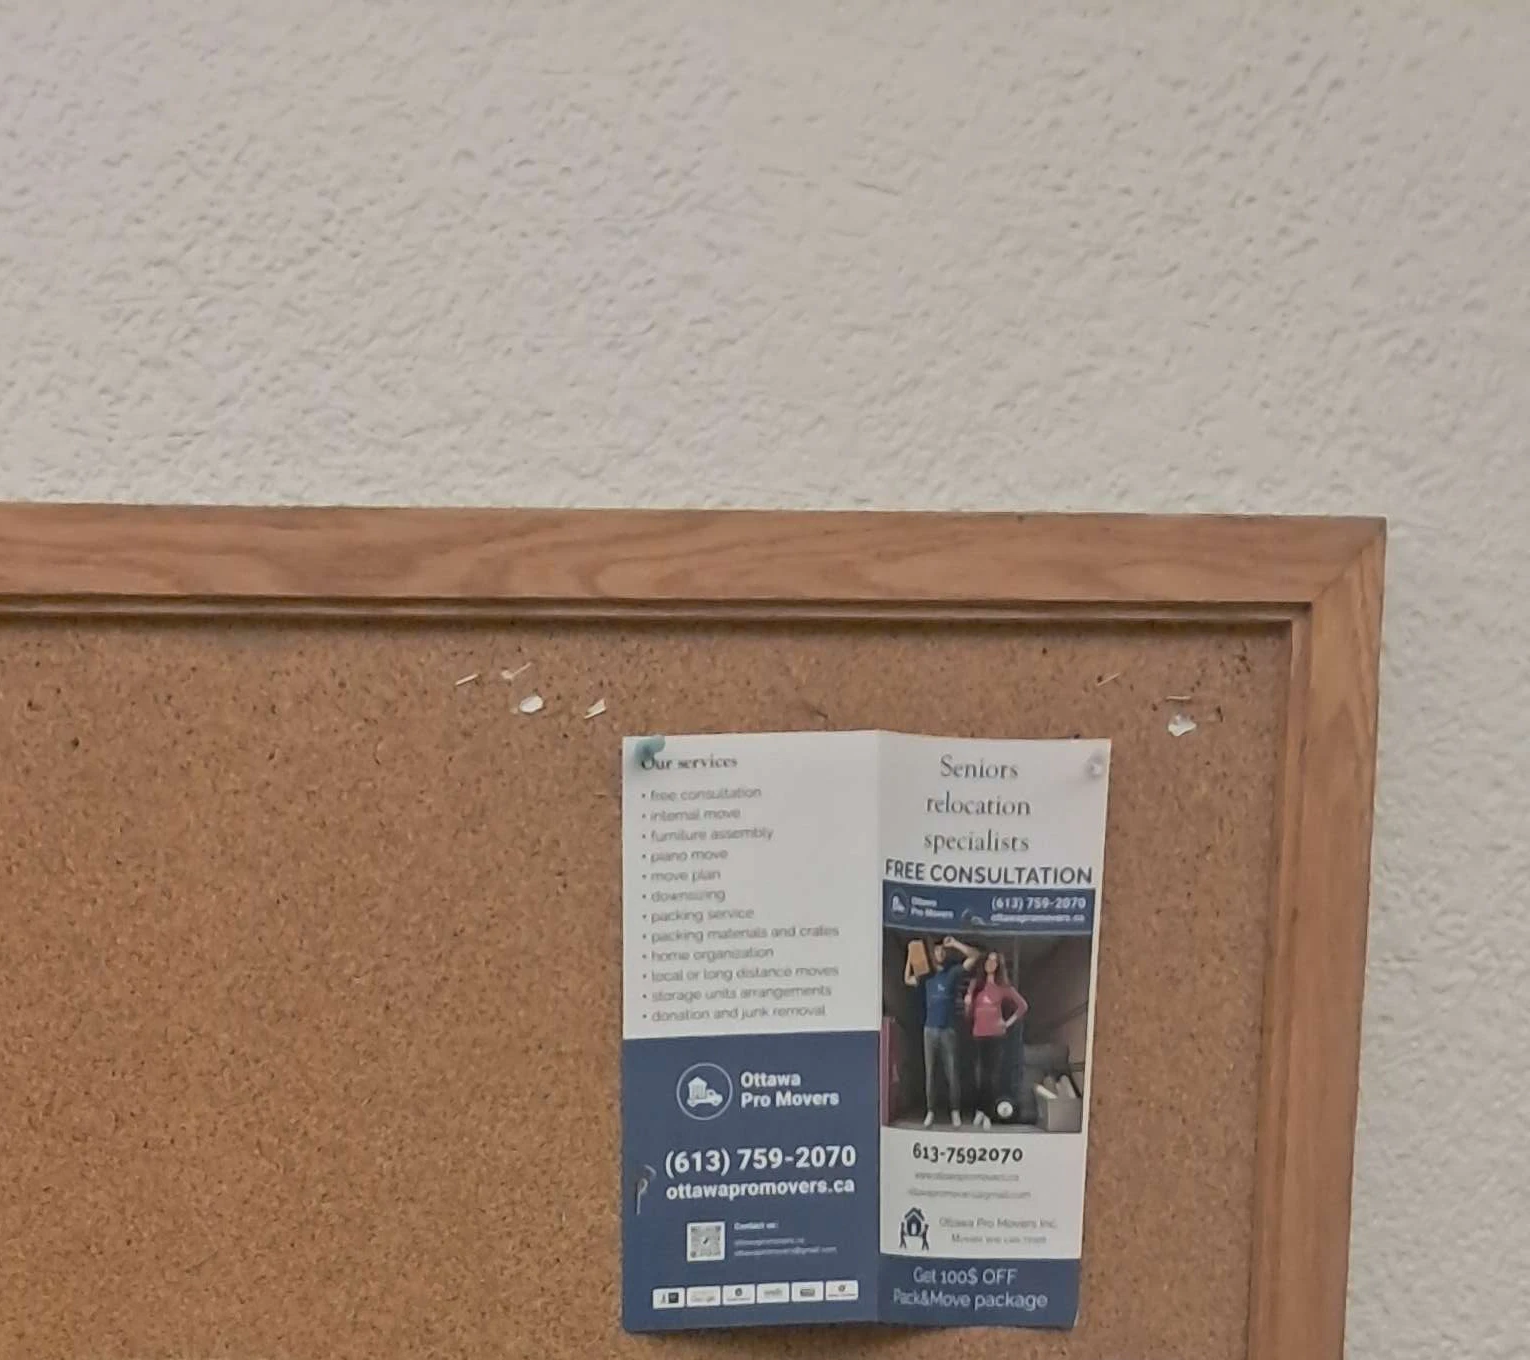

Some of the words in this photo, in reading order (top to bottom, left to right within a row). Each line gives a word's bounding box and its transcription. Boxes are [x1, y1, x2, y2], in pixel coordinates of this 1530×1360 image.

[640, 755, 673, 771] Our
[677, 753, 738, 769] services
[940, 754, 1018, 779] Seniors
[650, 789, 676, 801] free
[680, 787, 762, 801] consultation
[927, 790, 1031, 816] relocation
[703, 808, 741, 819] move
[651, 829, 707, 842] furniture
[711, 827, 774, 841] assembly
[924, 829, 1030, 854] specialists
[651, 850, 687, 863] piano
[691, 849, 728, 860] move
[651, 871, 688, 881] move
[692, 869, 721, 883] plan
[885, 858, 925, 881] FREE
[930, 864, 1093, 886] CONSULTATION
[651, 910, 704, 923] packing
[707, 908, 755, 919] service
[651, 930, 704, 944] packing
[707, 926, 767, 939] materials
[771, 926, 796, 937] and
[799, 925, 839, 937] crates
[651, 950, 689, 962] home
[693, 947, 774, 962] organization
[651, 970, 683, 982] local
[687, 971, 700, 981] or
[703, 969, 733, 982] long
[736, 966, 792, 978] distance
[795, 966, 839, 977] moves
[651, 990, 701, 1003] storage
[705, 988, 737, 1000] units
[740, 985, 832, 999] arrangements
[651, 1010, 710, 1022] donation
[714, 1007, 738, 1019] and
[741, 1006, 768, 1020] junk
[772, 1004, 826, 1017] removal
[740, 1071, 801, 1088] Ottawa
[741, 1092, 771, 1108] Pro
[775, 1091, 840, 1107] Movers
[665, 1148, 731, 1178] (613)
[736, 1145, 856, 1171] 759-2070
[913, 1142, 1024, 1164] 613-7592070
[666, 1178, 855, 1201] ottawapromovers.ca
[913, 1267, 937, 1284] Get
[942, 1268, 978, 1285] 100$
[983, 1268, 1018, 1285] OFF
[893, 1288, 970, 1308] Pack&Move
[975, 1292, 1048, 1312] package
